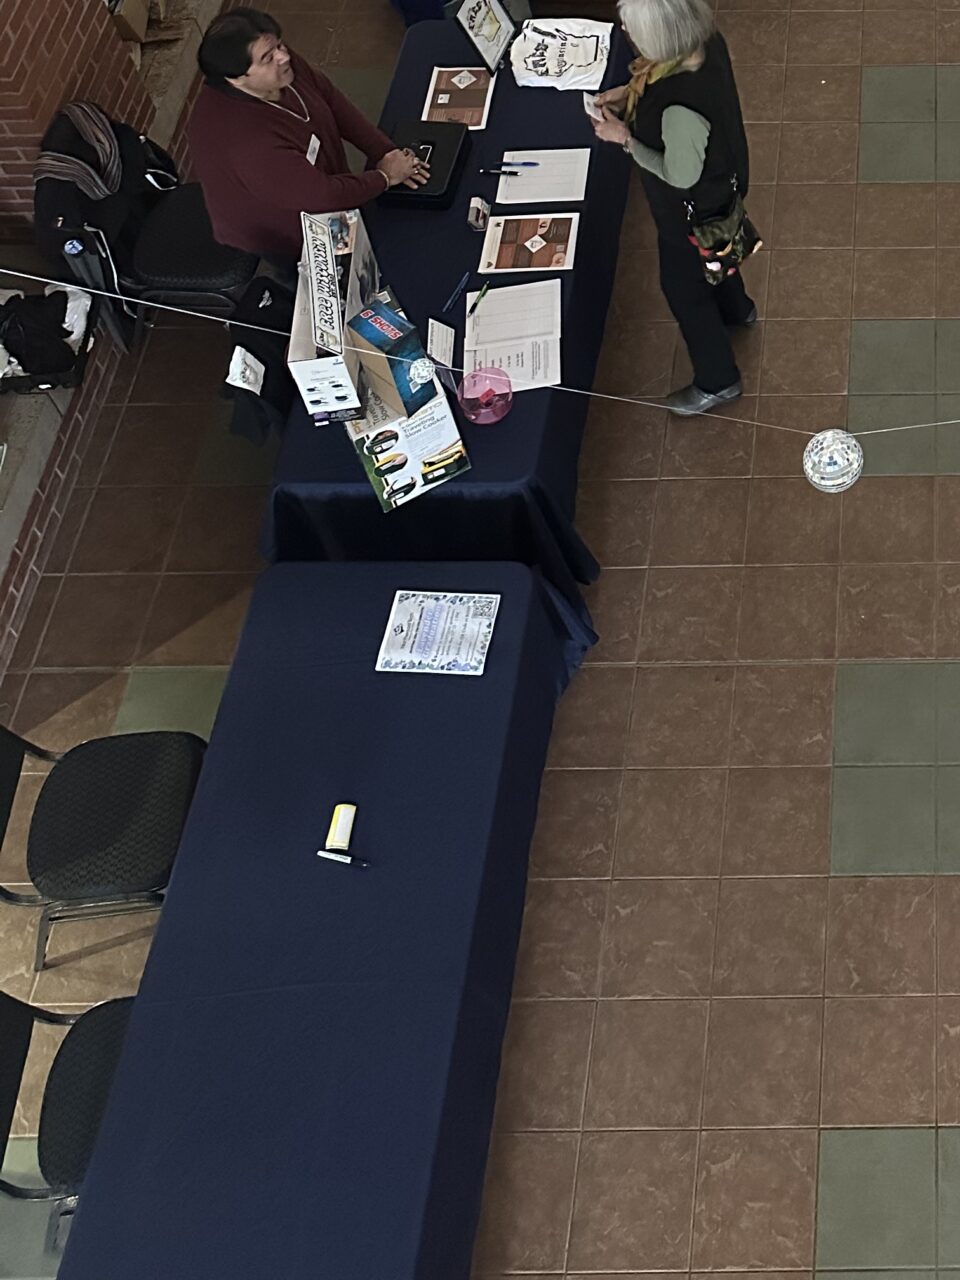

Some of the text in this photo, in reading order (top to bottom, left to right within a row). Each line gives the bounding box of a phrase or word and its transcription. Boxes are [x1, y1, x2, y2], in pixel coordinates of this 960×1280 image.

[311, 235, 335, 300] WISCONSIN
[360, 309, 404, 341] 6 SHOTS
[403, 416, 435, 435] Traveling
[421, 414, 448, 431] Cooker
